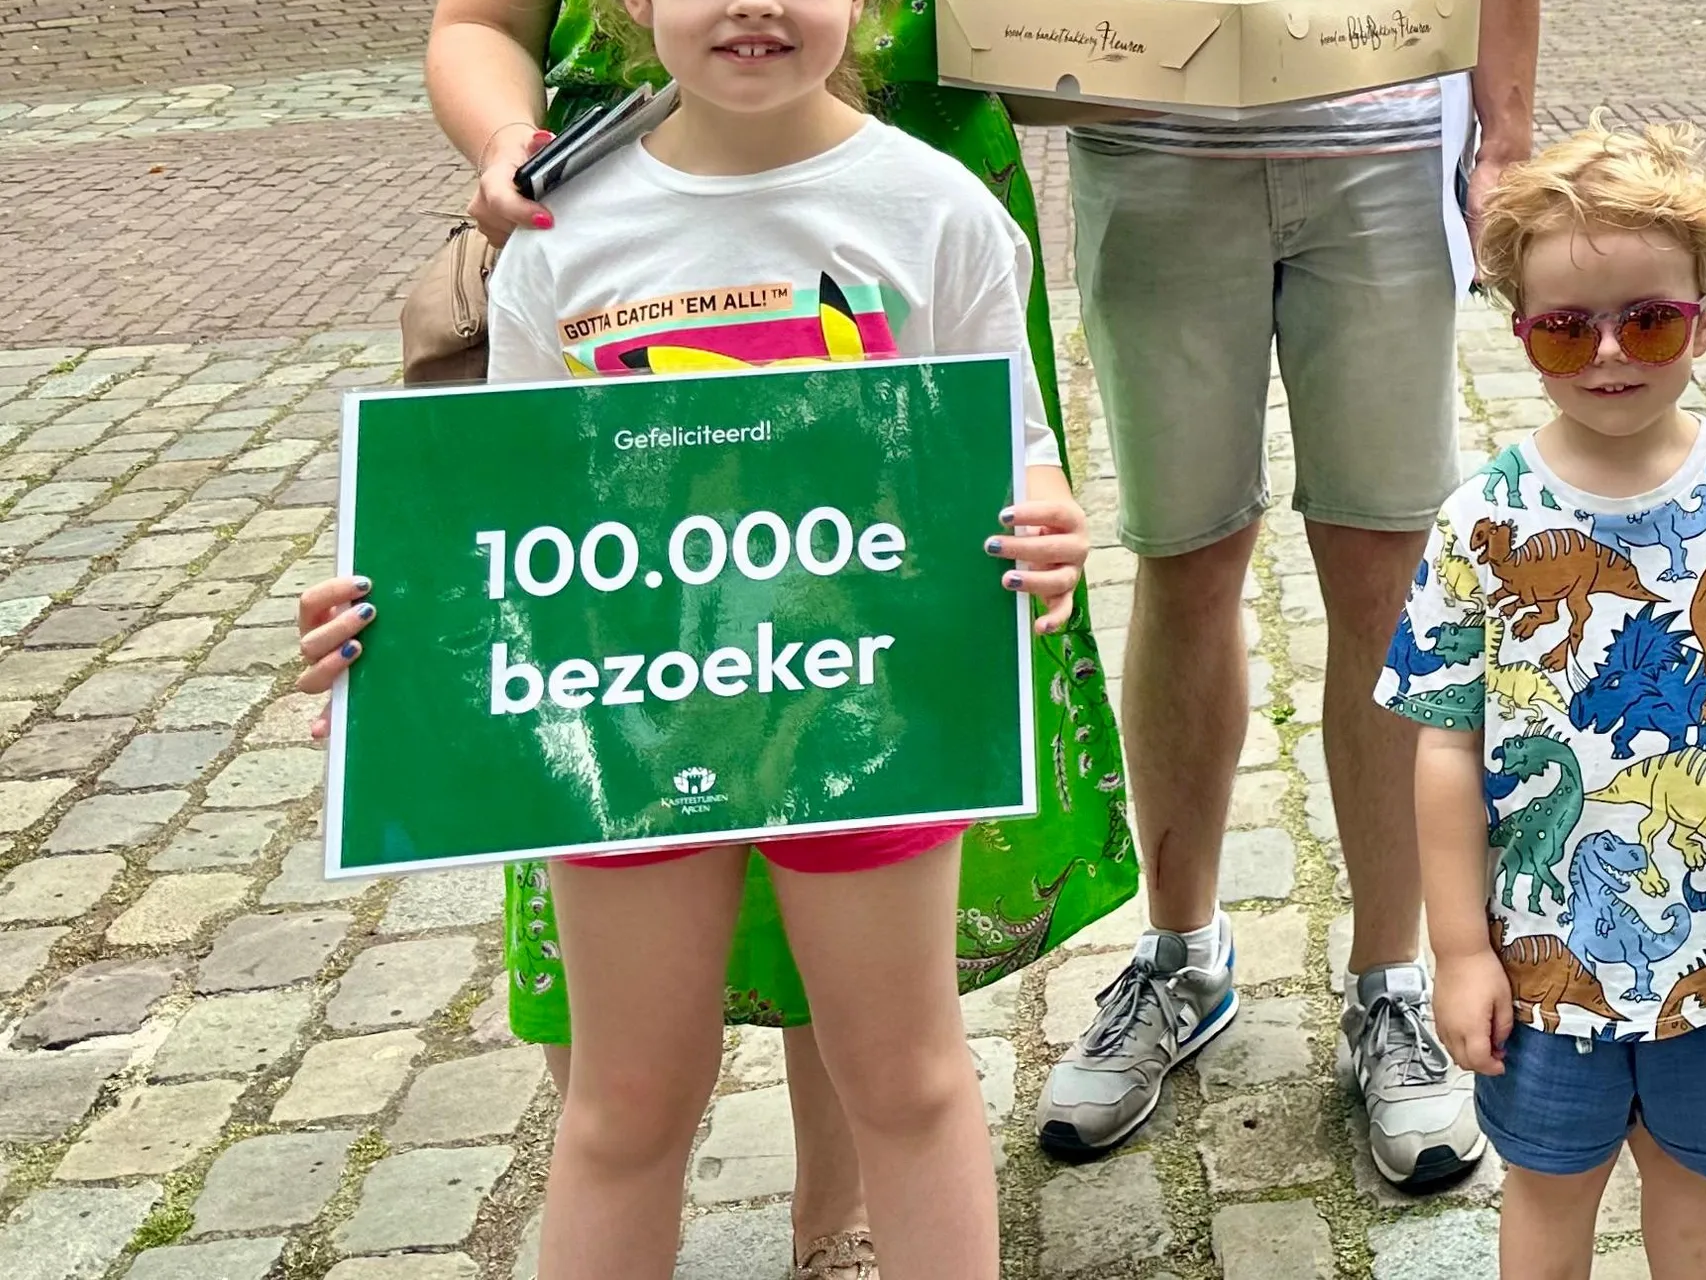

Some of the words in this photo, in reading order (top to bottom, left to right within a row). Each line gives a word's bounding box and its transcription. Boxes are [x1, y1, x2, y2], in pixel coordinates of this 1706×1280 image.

[1095, 20, 1147, 54] Fleuren
[1392, 10, 1432, 37] Fleuren
[563, 313, 612, 340] GOTTA
[616, 299, 674, 327] CATCH
[723, 290, 767, 310] ALL!
[613, 420, 773, 452] Gefeliciteerd!
[475, 506, 906, 600] 100.000e
[490, 622, 895, 716] bezoeker
